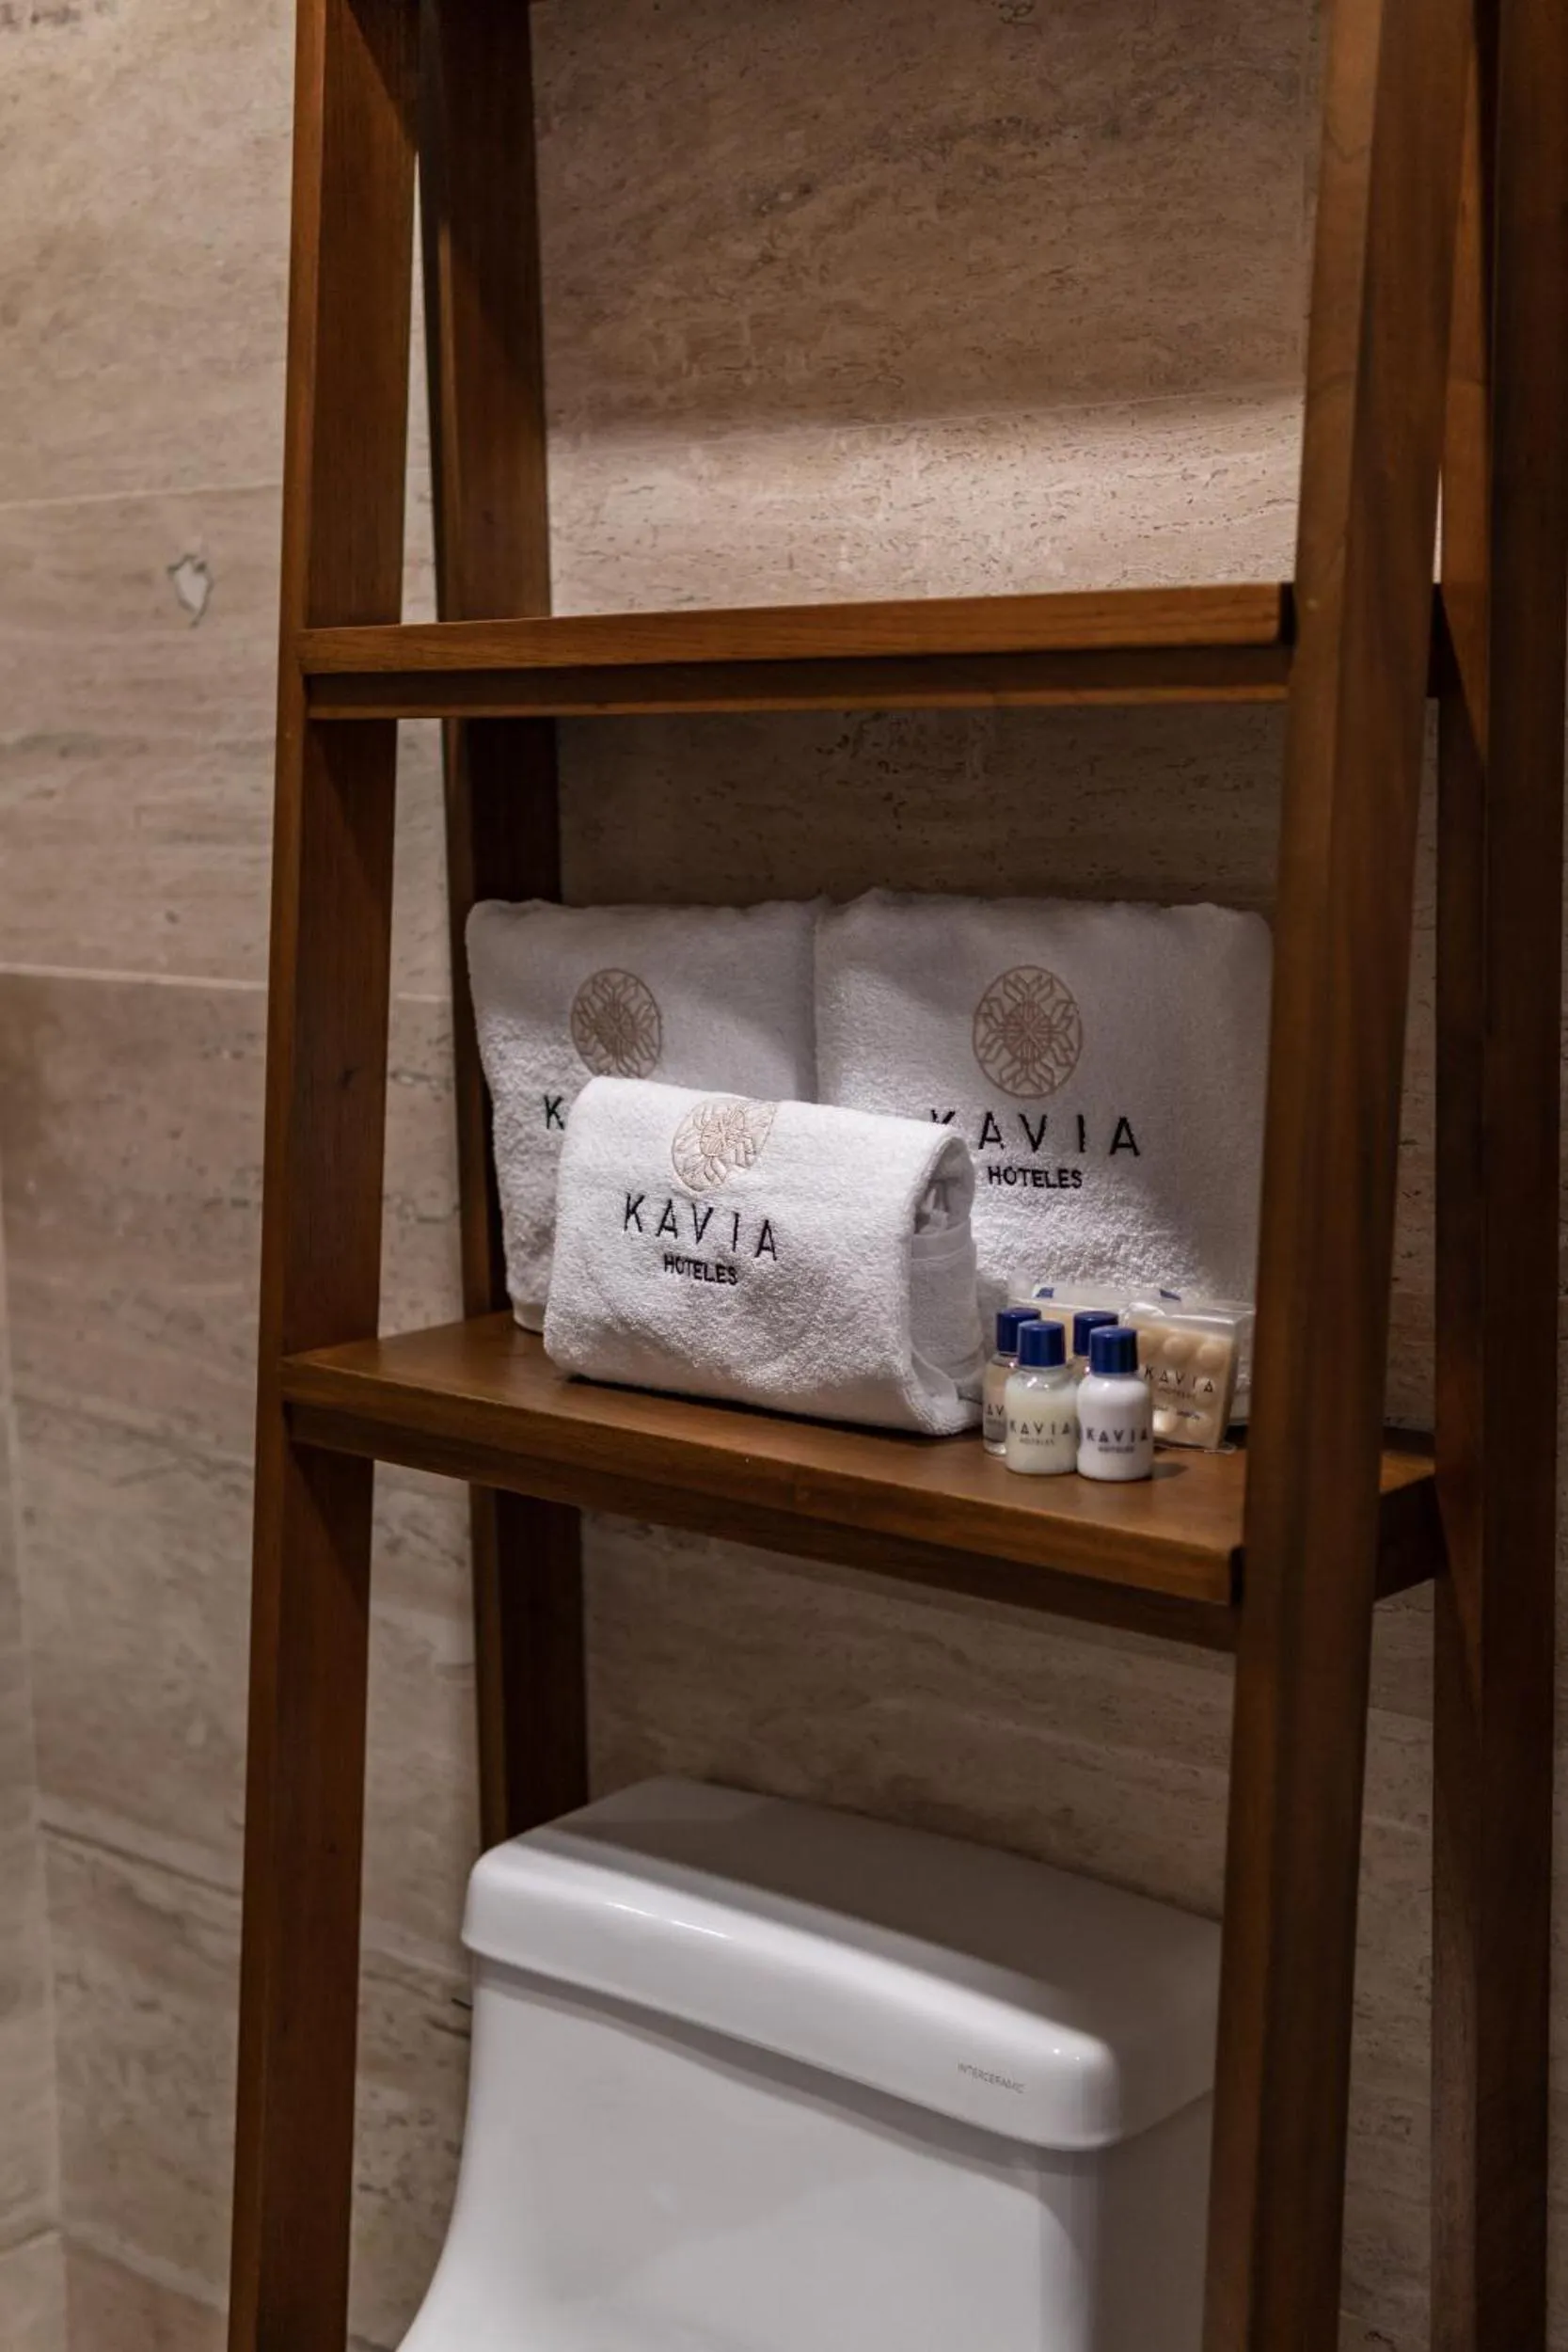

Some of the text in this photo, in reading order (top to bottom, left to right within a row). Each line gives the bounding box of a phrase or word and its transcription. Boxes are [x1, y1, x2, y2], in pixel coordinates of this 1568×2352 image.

[988, 1166, 1084, 1189] HOTELES
[624, 1192, 778, 1262] KAVIA
[663, 1253, 738, 1286] HOTELES
[1145, 1366, 1213, 1392] KAVIA
[1009, 1420, 1071, 1436] KAVIA
[1085, 1426, 1148, 1443] KAVIA
